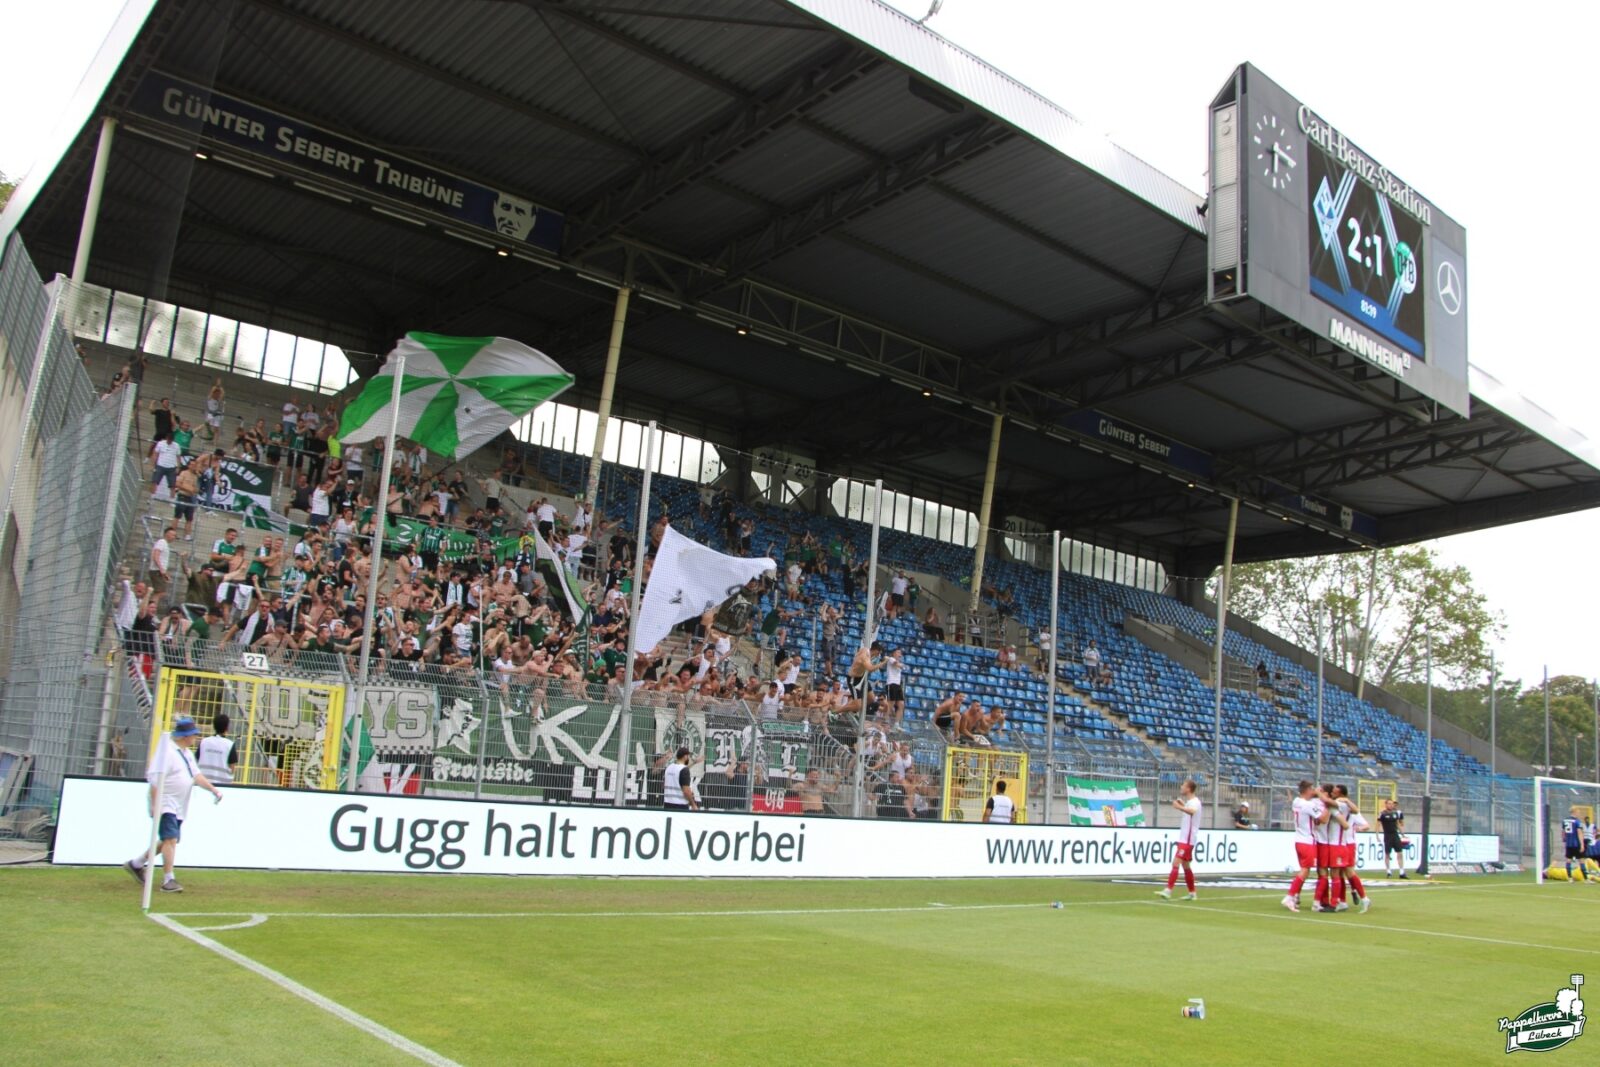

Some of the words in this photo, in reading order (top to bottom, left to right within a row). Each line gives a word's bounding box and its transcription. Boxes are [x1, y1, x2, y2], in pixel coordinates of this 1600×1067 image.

[1298, 104, 1431, 226] Carl-Benz-Stadion
[246, 655, 264, 667] 27
[330, 804, 469, 870] Gugg
[484, 809, 577, 859] halt
[591, 817, 672, 860] mol
[685, 821, 805, 862] vorbei
[987, 832, 1238, 864] www.renck-weinel.de
[1428, 838, 1458, 860] orbei
